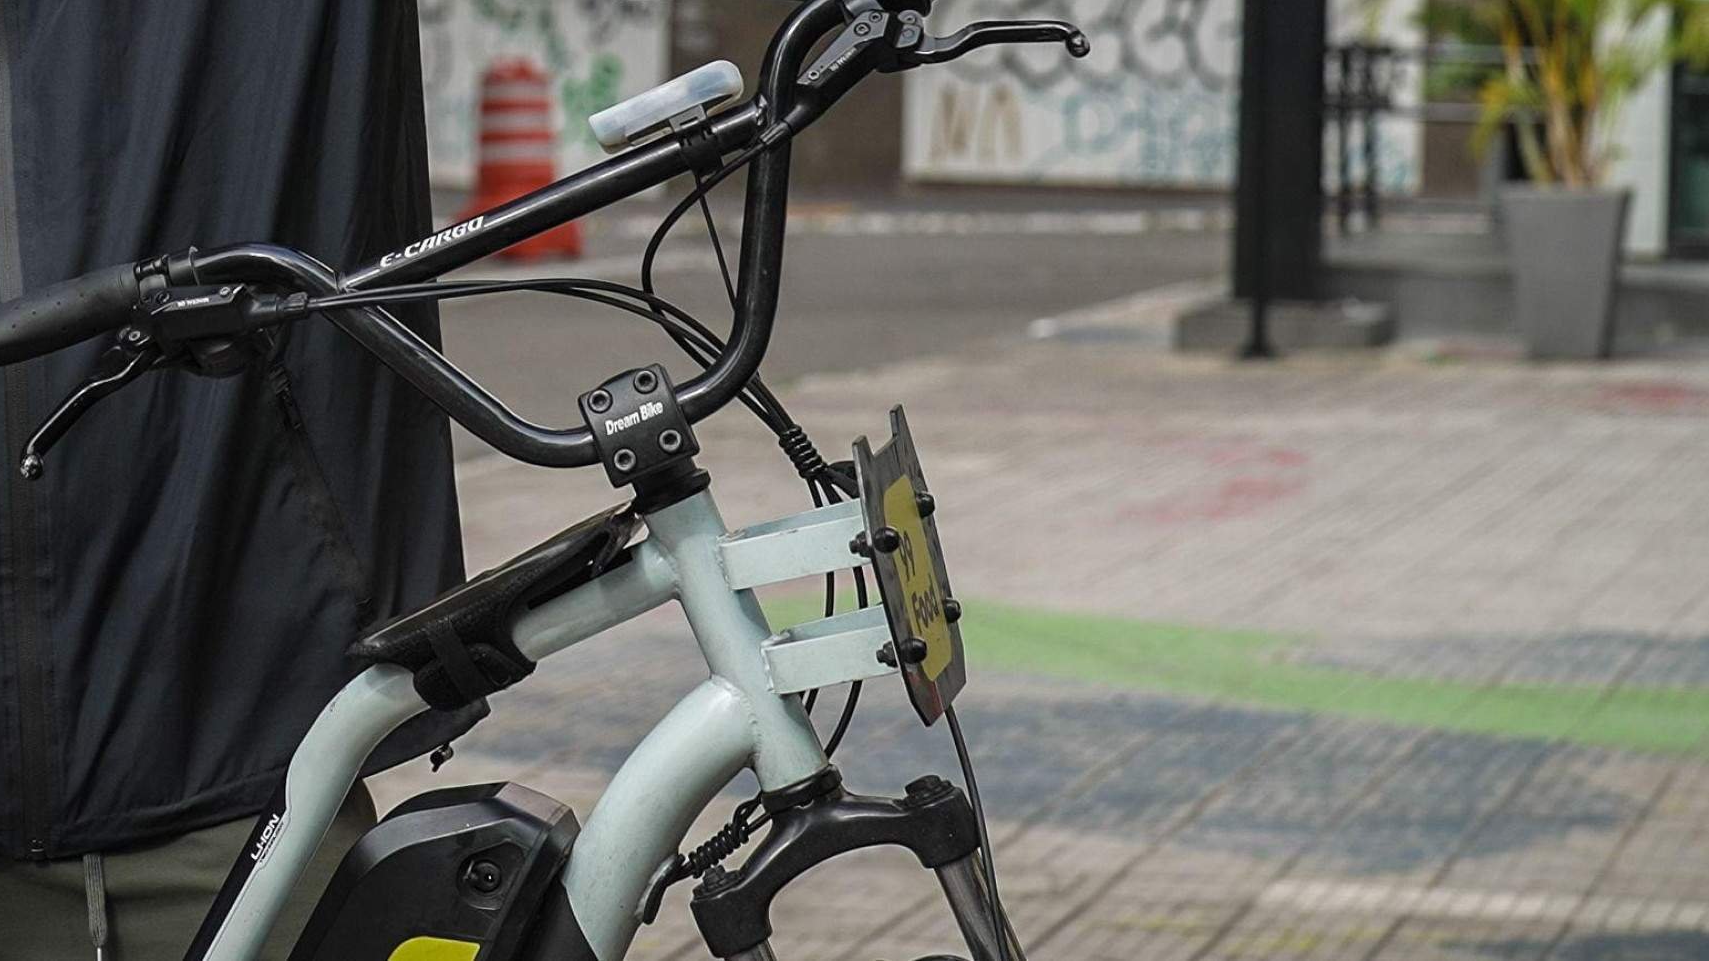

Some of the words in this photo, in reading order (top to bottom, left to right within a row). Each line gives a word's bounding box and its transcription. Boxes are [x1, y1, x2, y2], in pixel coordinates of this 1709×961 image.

[379, 216, 484, 268] E-CARGO
[605, 411, 641, 436] Dream
[639, 401, 664, 421] Bike
